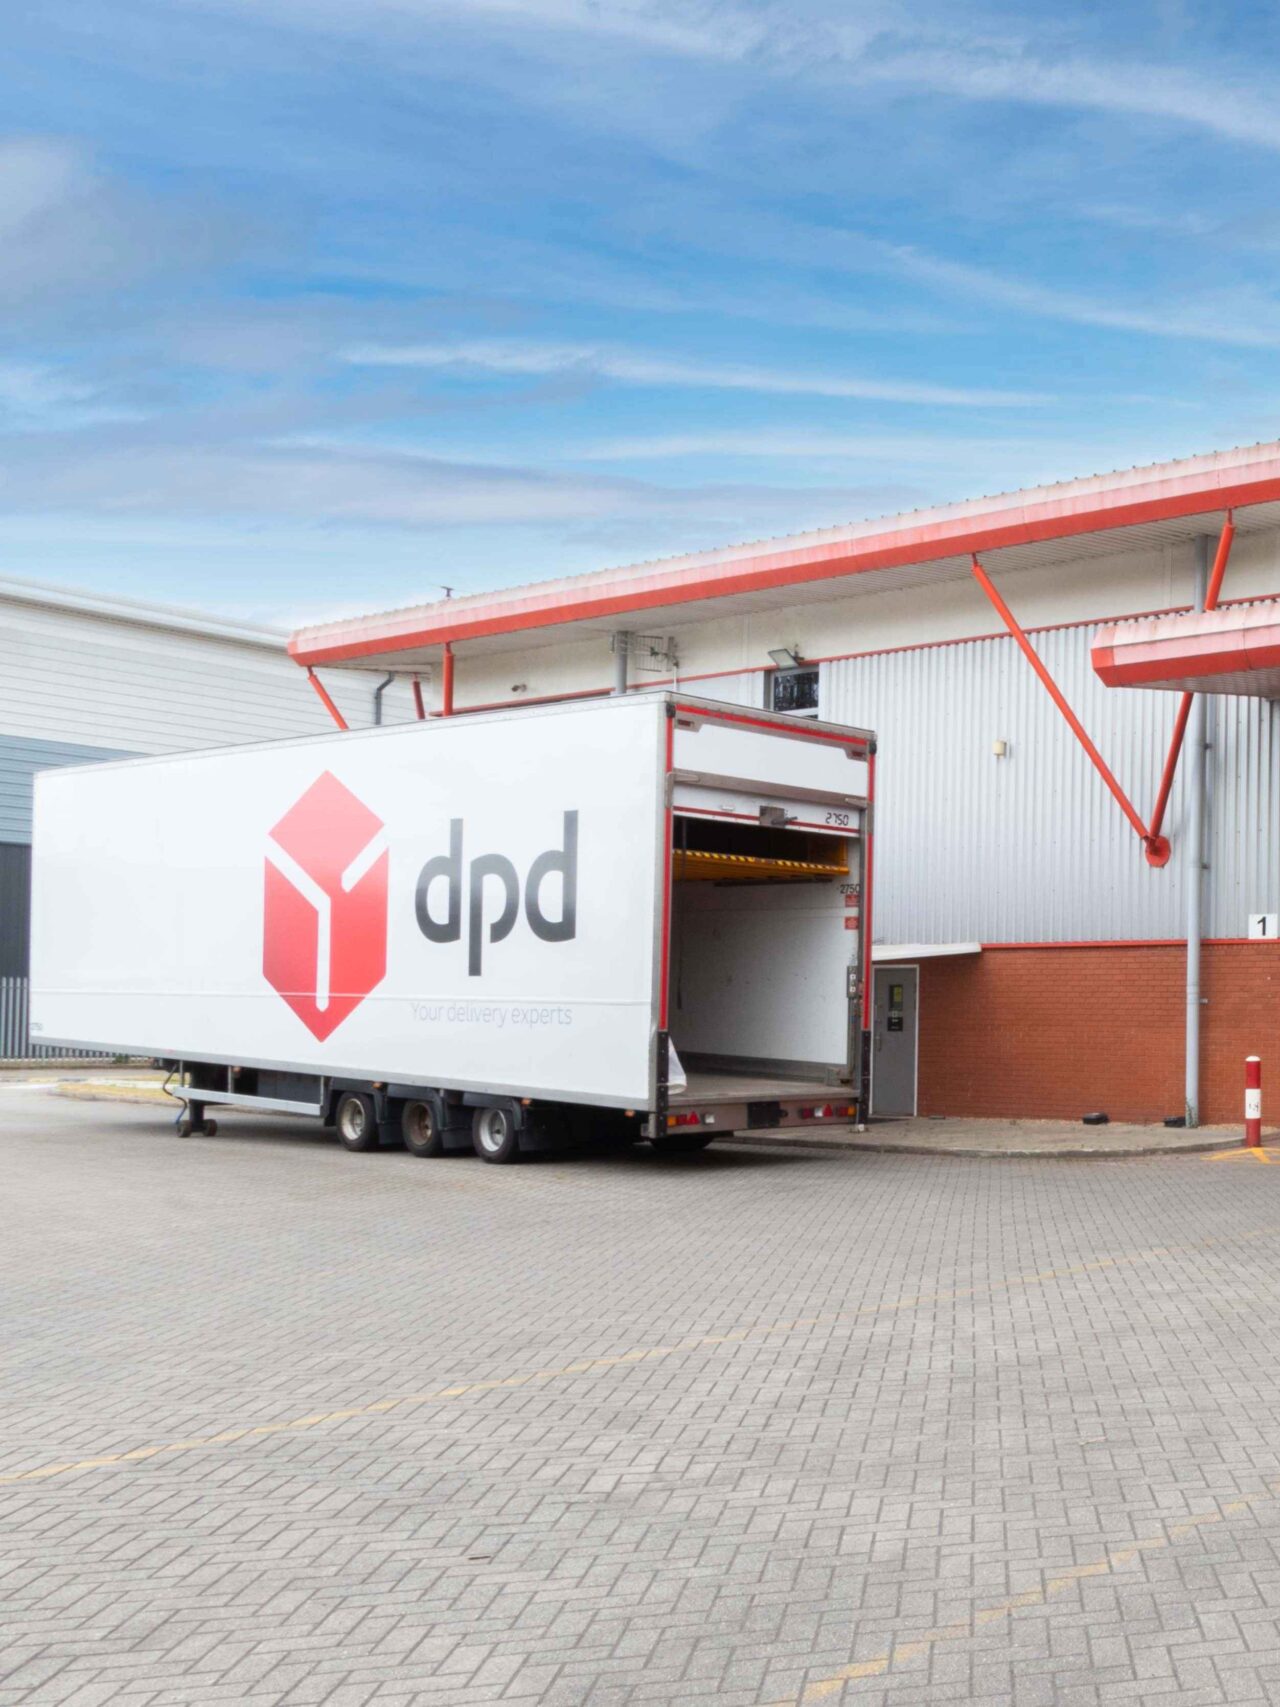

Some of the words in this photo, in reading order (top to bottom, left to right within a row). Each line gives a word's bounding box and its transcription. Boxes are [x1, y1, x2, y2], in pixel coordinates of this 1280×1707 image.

[825, 812, 849, 826] 2750
[415, 809, 577, 976] dpd
[1257, 916, 1266, 936] 1
[411, 1002, 444, 1021] Your
[448, 1003, 507, 1028] delivery
[511, 1005, 573, 1029] experts
